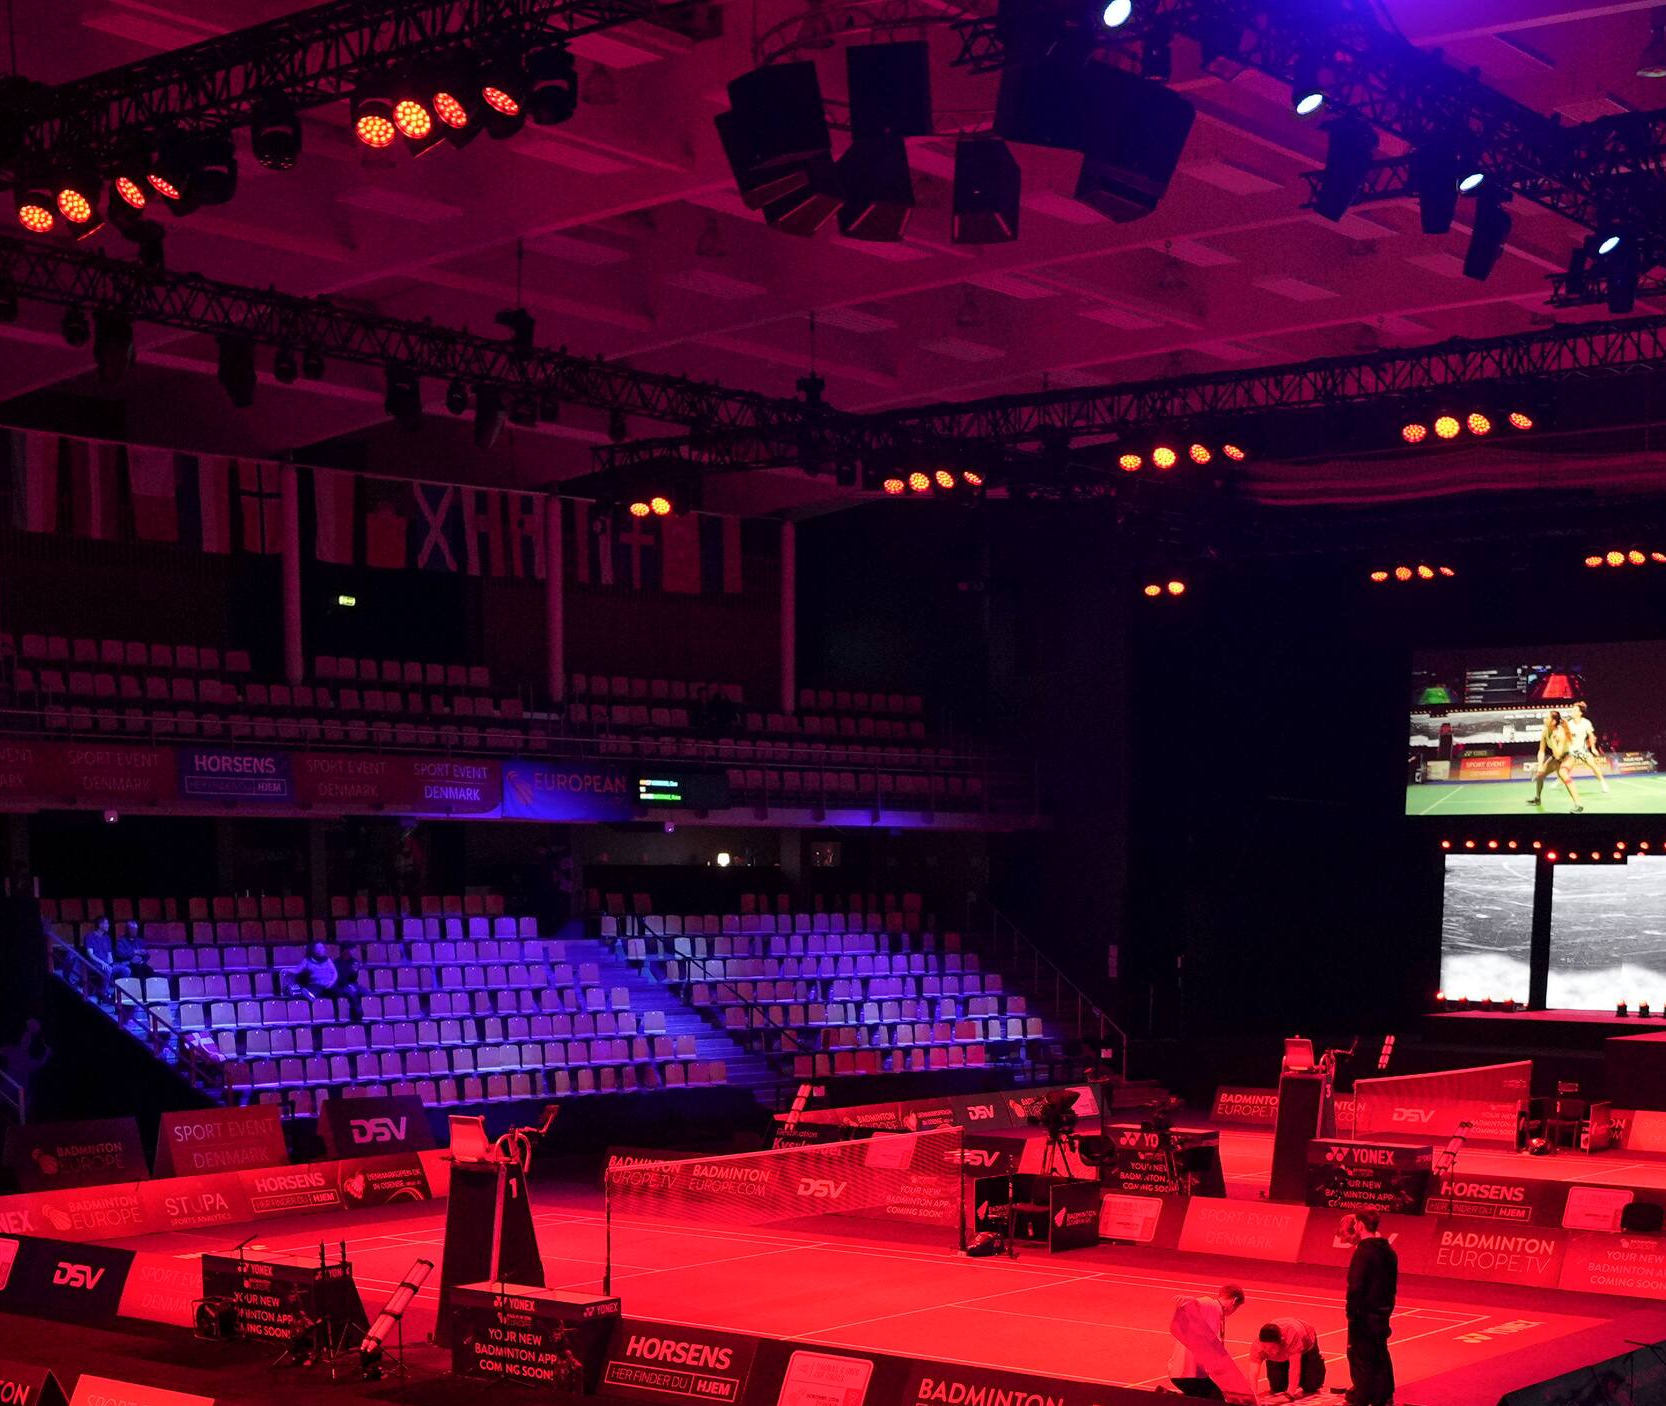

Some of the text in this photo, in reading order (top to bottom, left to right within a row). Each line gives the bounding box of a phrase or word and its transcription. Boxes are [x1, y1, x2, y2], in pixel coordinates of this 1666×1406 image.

[68, 751, 159, 768] SPORT EVENT
[195, 754, 276, 774] HORSENS
[306, 759, 387, 776] SPORT EVENT
[414, 763, 488, 780] SPORT EVENT
[82, 775, 150, 792] DENMARK
[533, 772, 627, 794] EUROPEAN
[424, 785, 480, 801] DENMARK
[1221, 1093, 1279, 1106] BADMINTO
[1326, 1083, 1332, 1098] 3
[966, 1105, 996, 1121] DSV
[1393, 1107, 1435, 1123] DSV
[175, 1118, 276, 1142] SPORT EVENT
[349, 1116, 406, 1144] DSV
[57, 1142, 123, 1158] BADMINTON
[194, 1147, 269, 1169] DENMARK
[1352, 1148, 1395, 1166] YONEX
[255, 1171, 326, 1193] HORSENS
[692, 1163, 772, 1184] BADMINTON
[510, 1177, 519, 1199] 1
[688, 1178, 767, 1197] EUROPE.COM
[796, 1176, 848, 1199] DSV
[1441, 1180, 1525, 1202] HORSENS
[68, 1195, 139, 1213] BADMINTON
[1499, 1207, 1526, 1219] HJEM
[71, 1206, 144, 1231] EUROPE
[1440, 1231, 1555, 1255] BADMINTON
[1435, 1249, 1551, 1274] EUROPE.TV
[1606, 1249, 1665, 1264] YOUR NEW
[52, 1261, 106, 1290] DSV
[141, 1265, 177, 1283] SPORT
[1588, 1262, 1654, 1278] BADMINTON
[1589, 1275, 1631, 1288] COMING
[260, 1294, 281, 1309] NEW
[510, 1297, 536, 1313] YONEX
[597, 1301, 619, 1316] YONEX
[518, 1332, 543, 1347] NEW
[474, 1342, 558, 1366] BADMINTON APP
[626, 1335, 734, 1371] HORSENS
[522, 1364, 555, 1382] SOON!
[611, 1366, 732, 1396] HER FINDER DU HJEM
